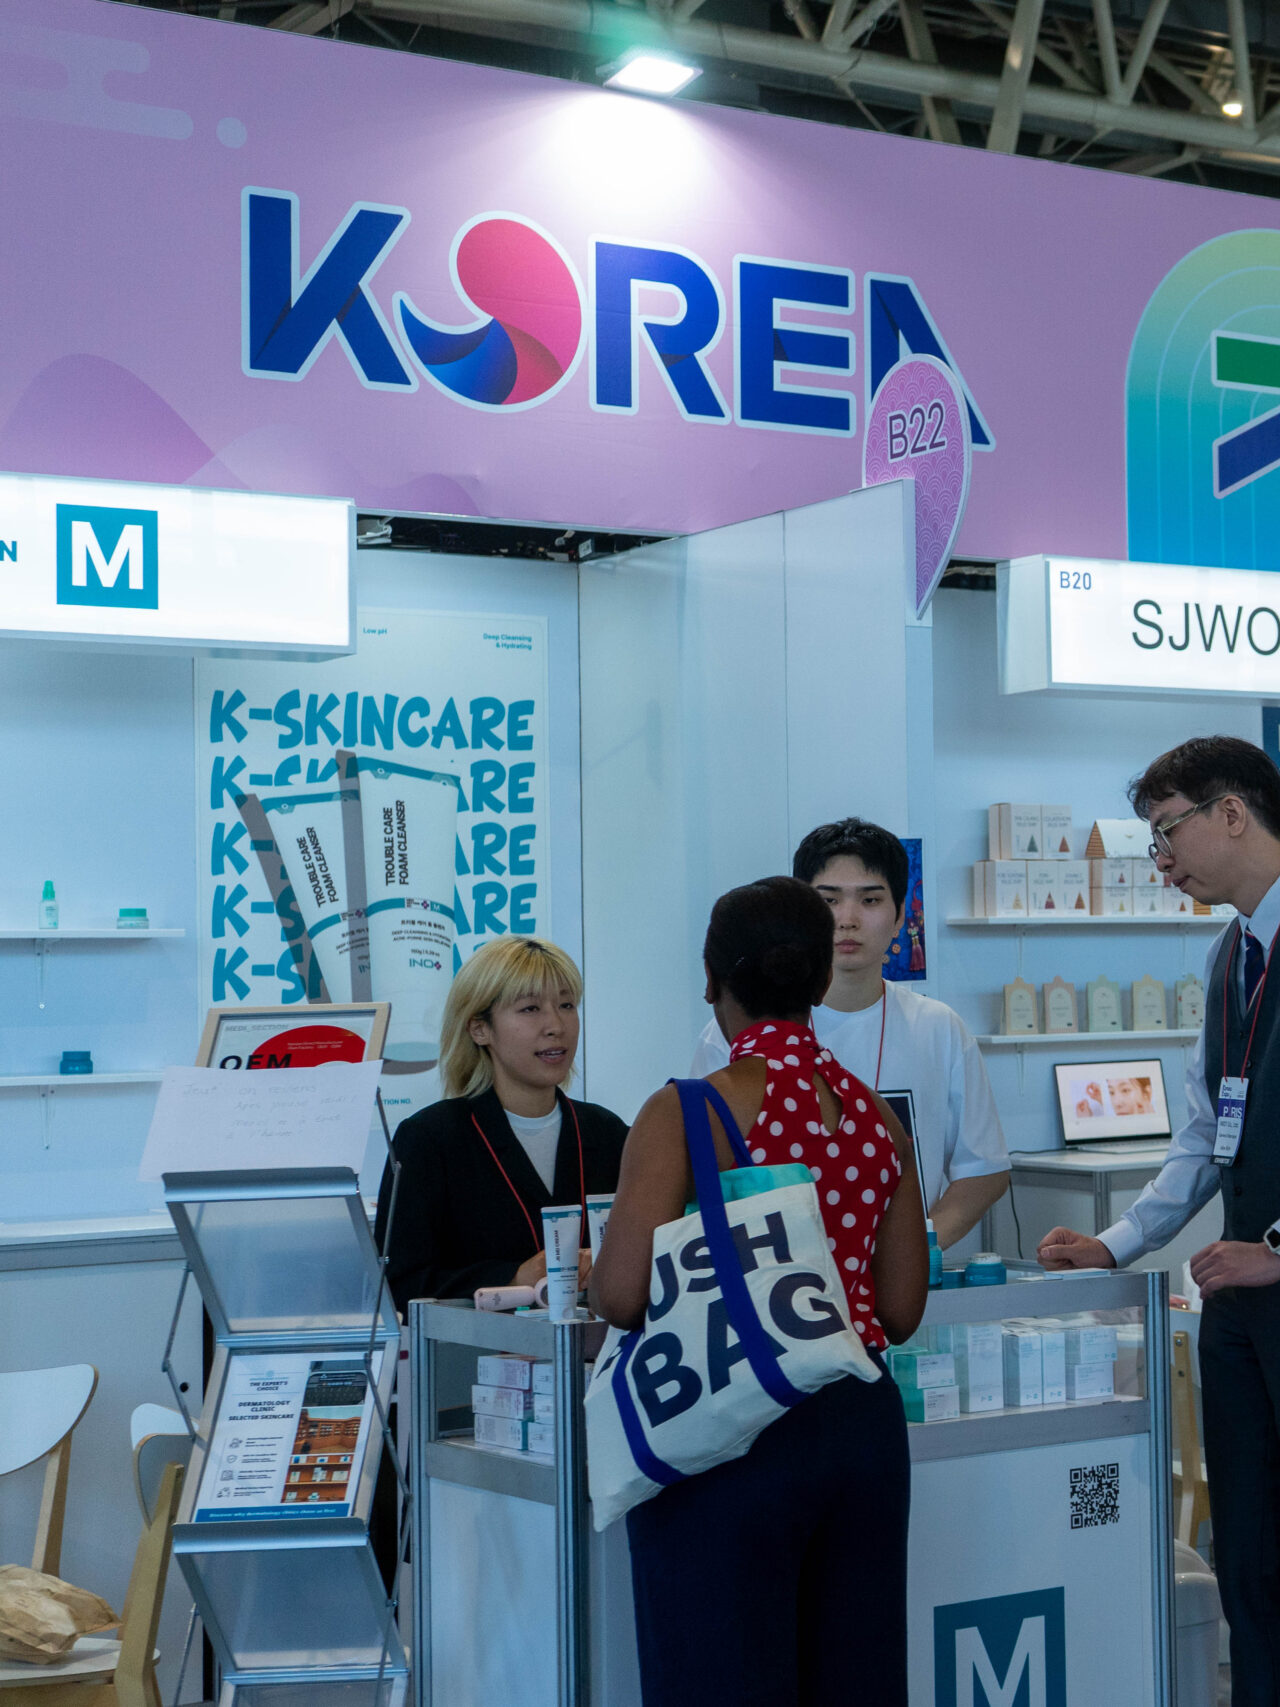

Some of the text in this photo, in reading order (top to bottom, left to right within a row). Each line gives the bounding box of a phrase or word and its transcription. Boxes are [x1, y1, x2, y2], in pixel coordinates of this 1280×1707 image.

[245, 190, 993, 449] KOREA
[887, 401, 946, 461] B22
[71, 520, 144, 590] M
[1060, 571, 1092, 590] B20
[363, 627, 376, 635] Low
[483, 633, 532, 643] Deep Cleansing
[501, 642, 532, 651] Hydrating
[210, 689, 535, 751] K-SKINCARE
[296, 836, 326, 908] TROUBLE CARE
[306, 826, 340, 903] FOAM CLEANSER
[383, 807, 395, 887] TROUBLE CARE
[396, 799, 409, 886] FOAM CLEANSER
[1223, 1106, 1242, 1118] PRIS
[649, 1211, 794, 1322] USH
[631, 1272, 848, 1428] BAG
